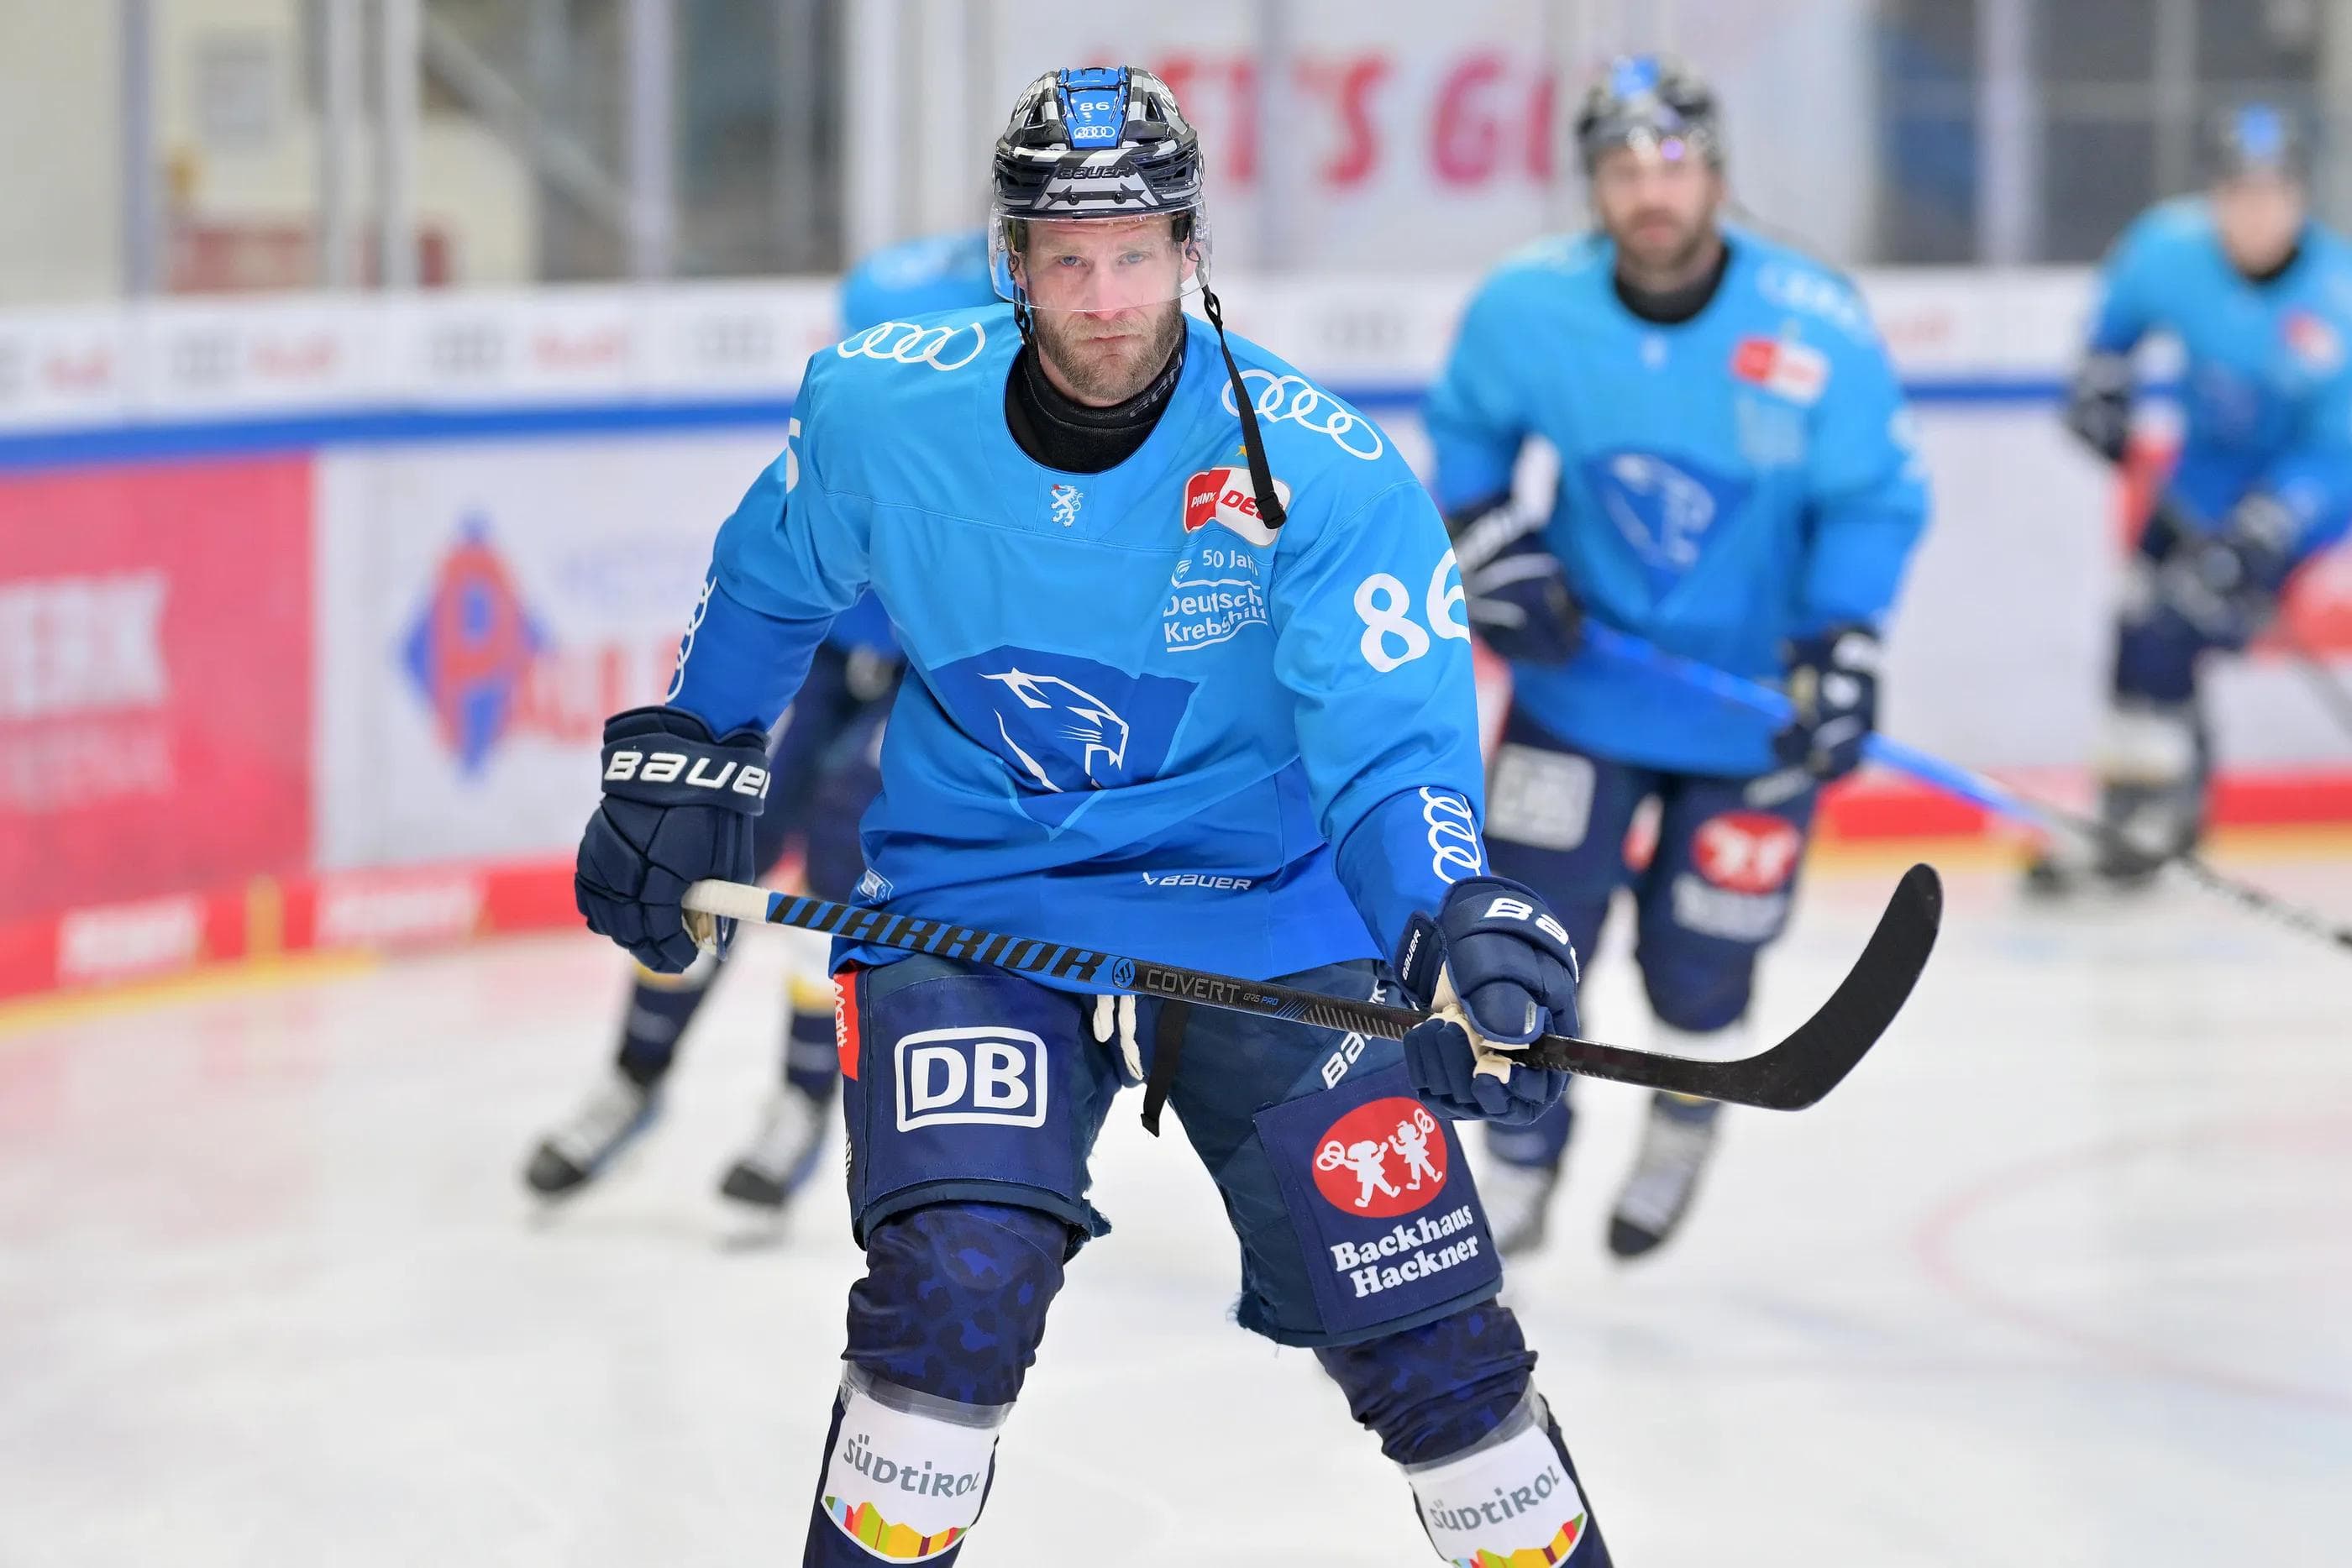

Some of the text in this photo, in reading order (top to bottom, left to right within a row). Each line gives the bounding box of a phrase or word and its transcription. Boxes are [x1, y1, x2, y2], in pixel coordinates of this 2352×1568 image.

[1079, 101, 1110, 112] 86
[1202, 549, 1224, 568] 50
[1353, 547, 1472, 673] 86
[1159, 874, 1252, 891] BAUER
[1402, 928, 1422, 981] BAUER
[1145, 968, 1242, 1004] COVERT
[1261, 996, 1279, 1006] PRO
[911, 1042, 1030, 1114] DB
[1330, 1204, 1474, 1272] Backhaus
[1349, 1235, 1479, 1298] Hackner
